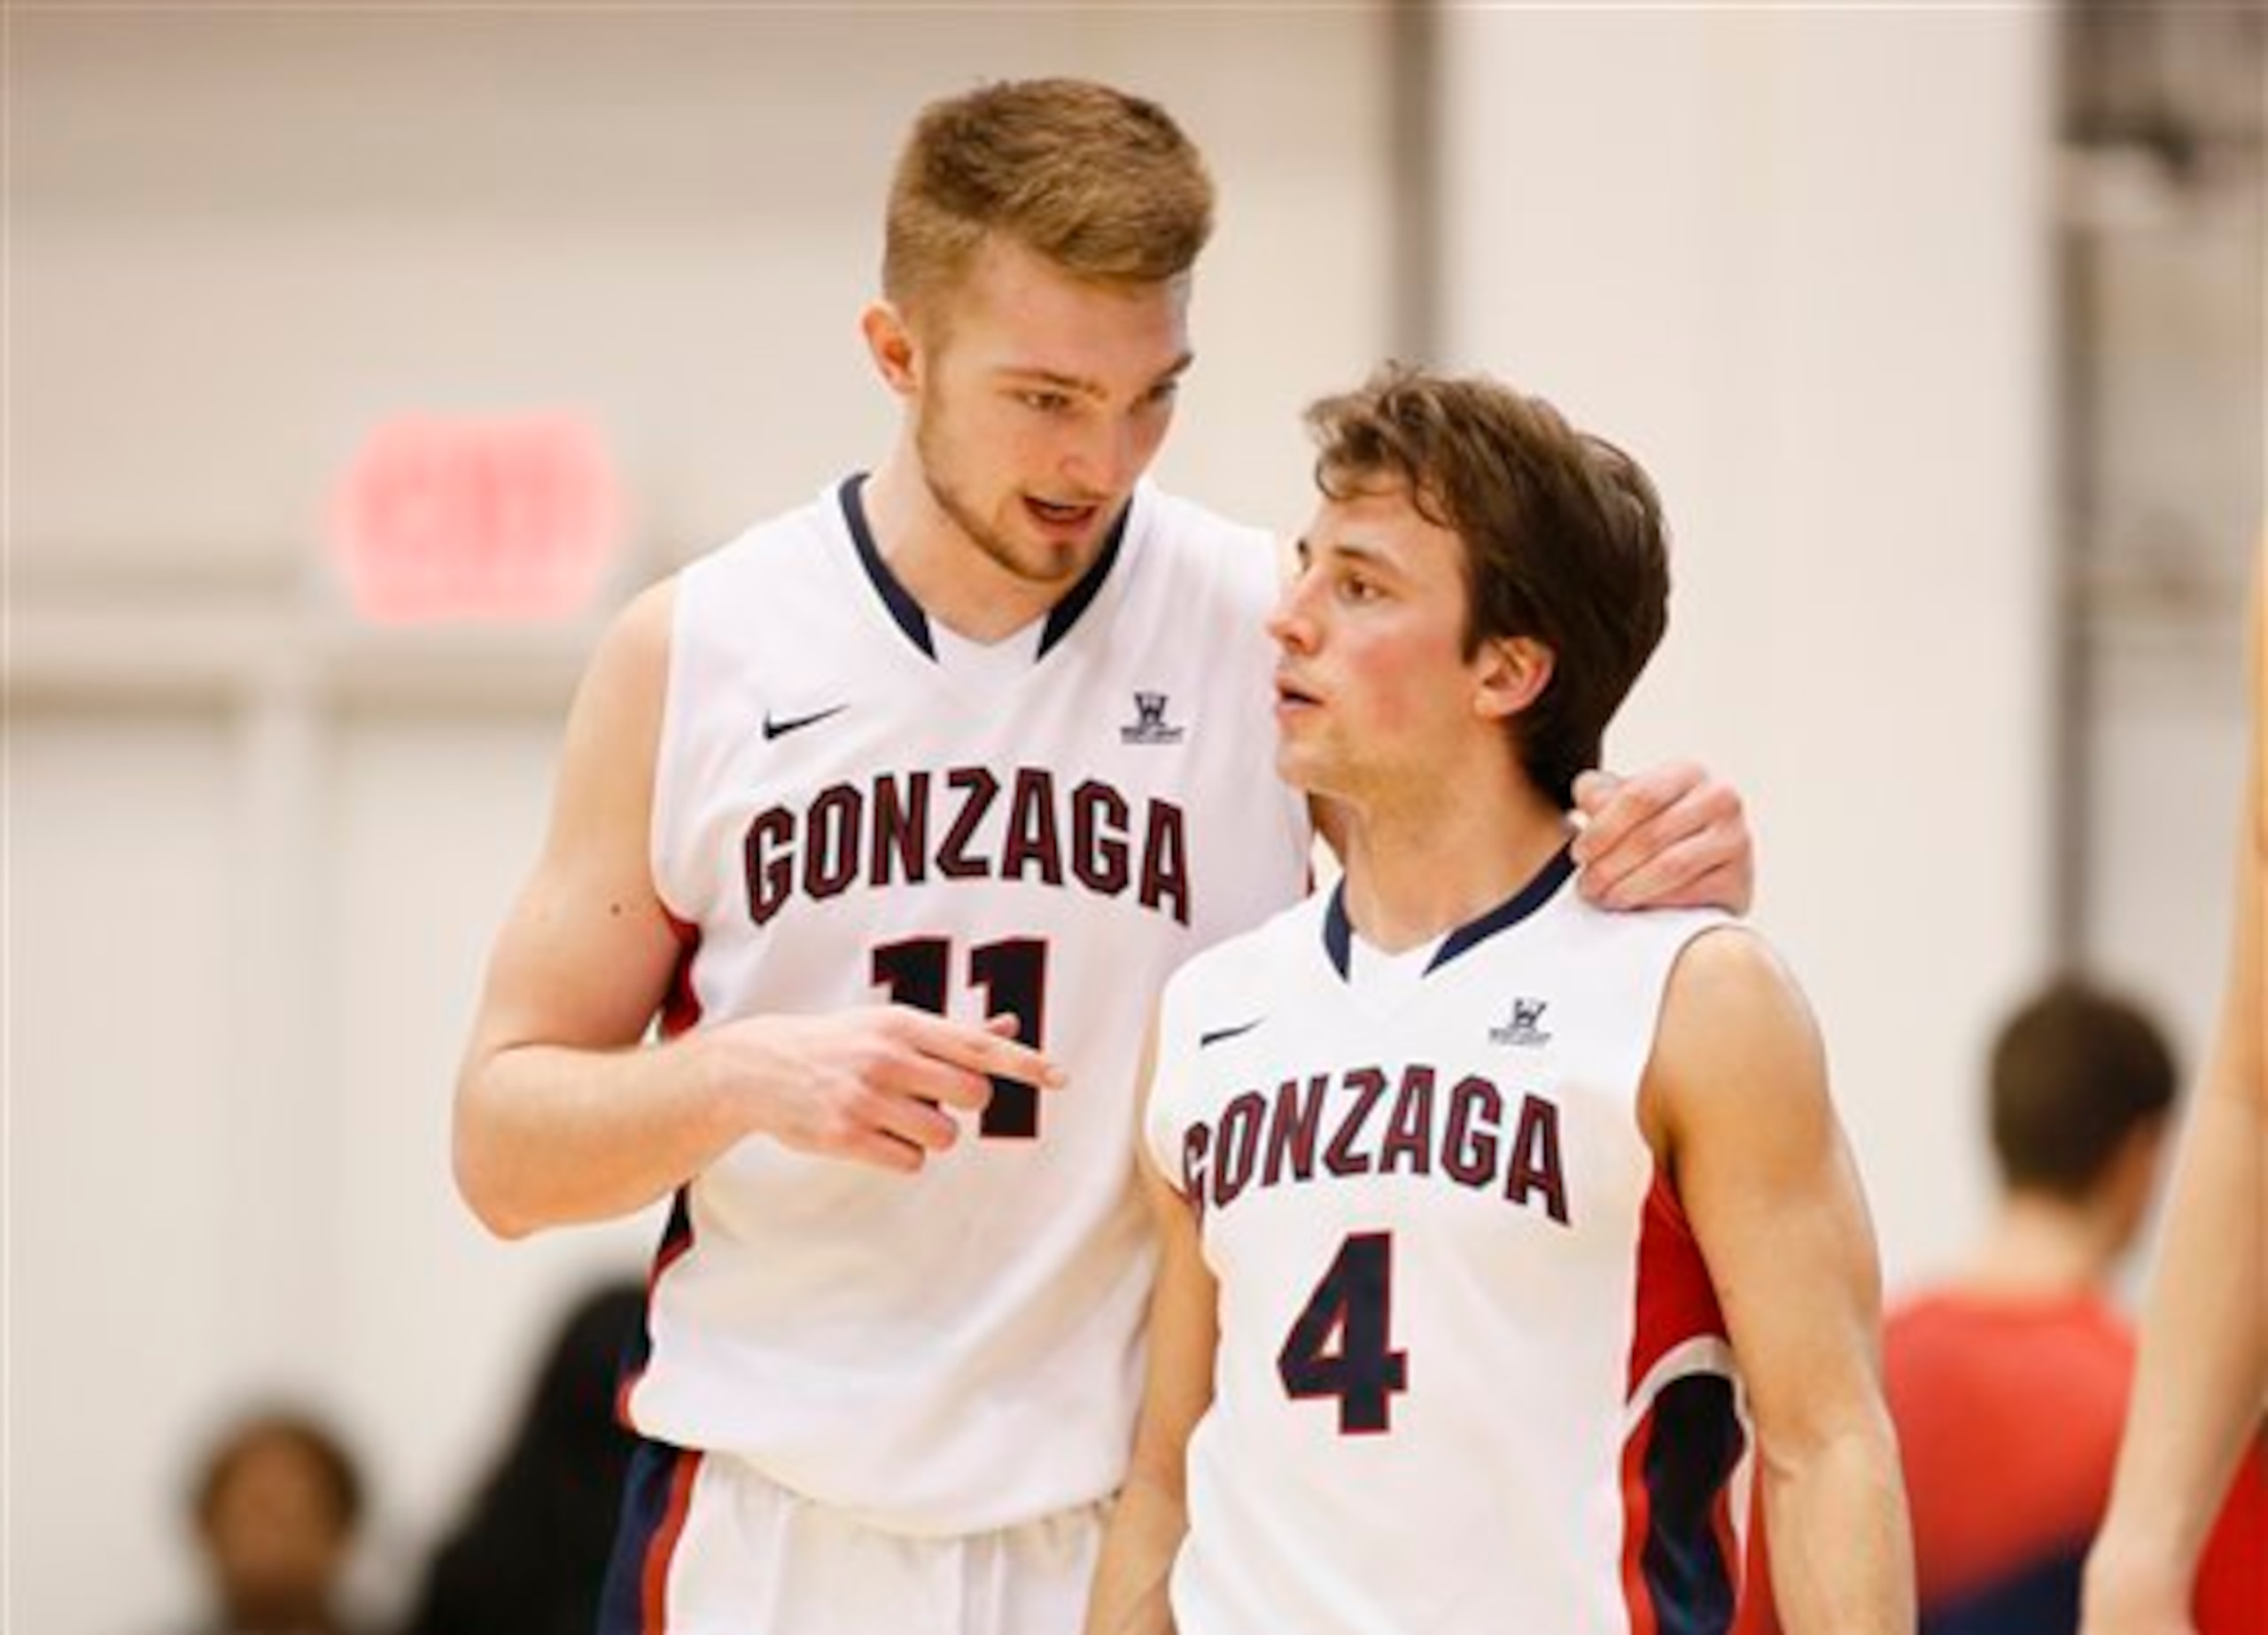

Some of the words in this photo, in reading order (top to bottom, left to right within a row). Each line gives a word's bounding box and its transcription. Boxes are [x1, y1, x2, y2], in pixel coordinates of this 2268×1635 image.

[743, 766, 1191, 927] GONZAGA
[1183, 1063, 1571, 1230] GONZAGA
[1277, 1230, 1409, 1436] 4
